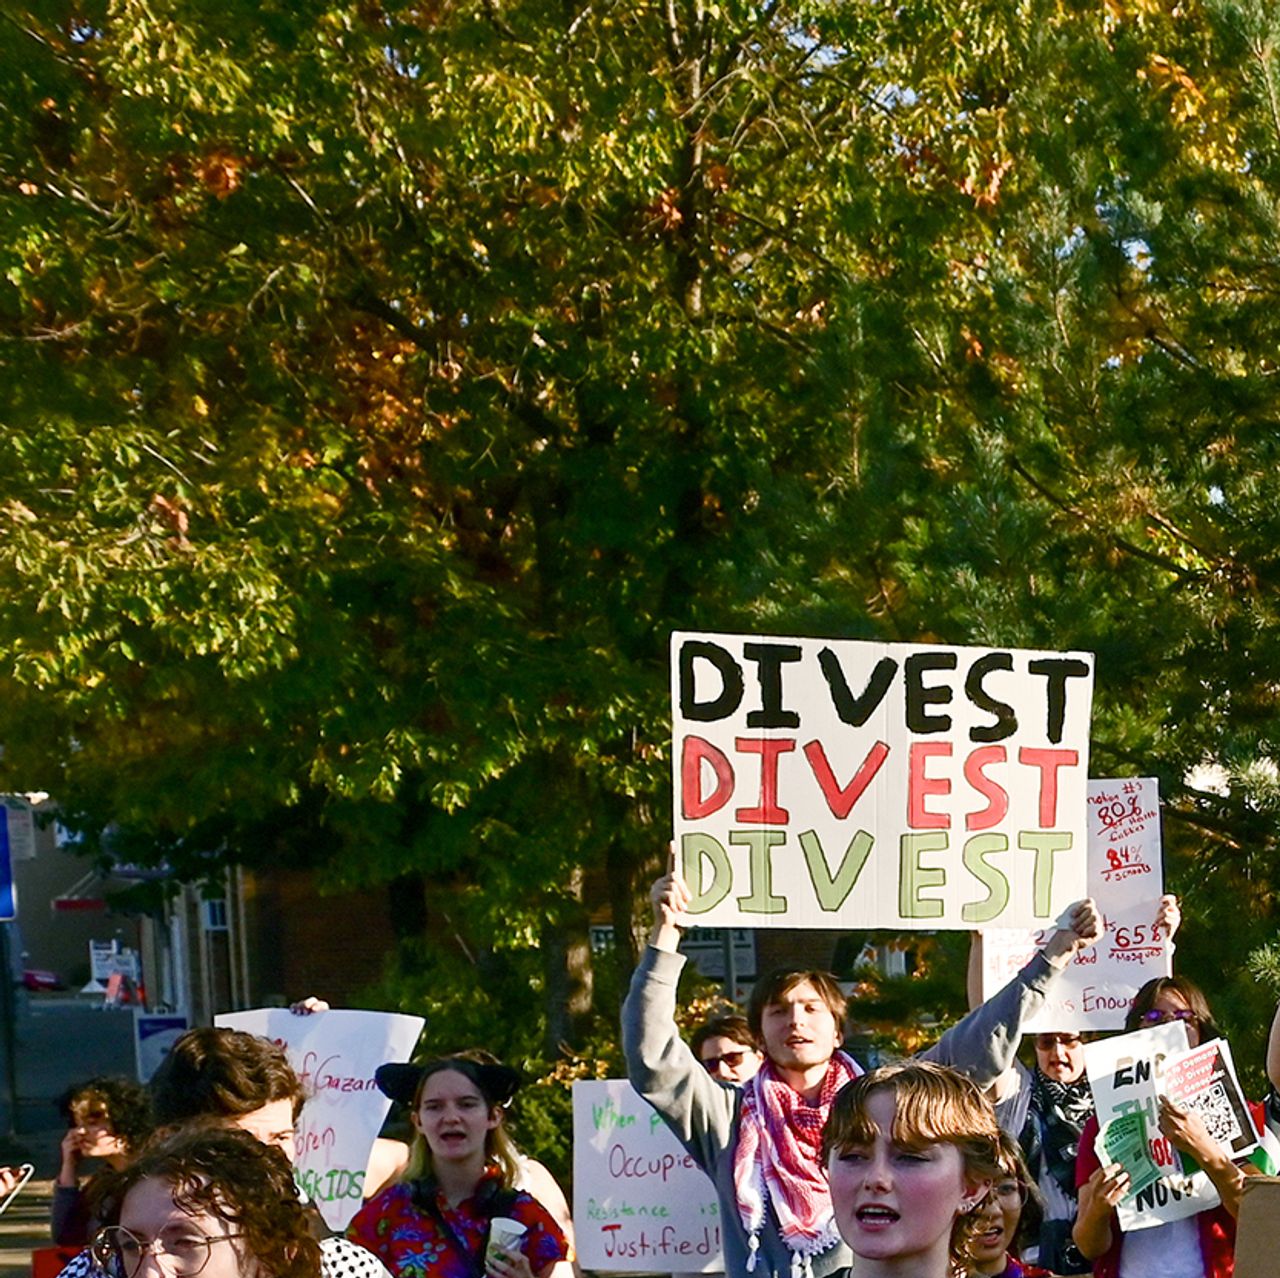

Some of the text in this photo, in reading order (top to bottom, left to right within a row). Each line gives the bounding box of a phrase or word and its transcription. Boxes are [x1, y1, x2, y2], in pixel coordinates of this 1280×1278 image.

[678, 639, 1090, 744] DIVEST
[680, 736, 1080, 830] DIVEST
[1106, 844, 1143, 870] 84%
[680, 830, 1073, 922] DIVEST
[592, 1099, 637, 1130] When
[1112, 1093, 1156, 1128] TH
[608, 1143, 703, 1183] Occupie
[587, 1198, 719, 1221] Resistance is
[1136, 1178, 1194, 1213] NOW
[601, 1222, 721, 1258] Justified!
